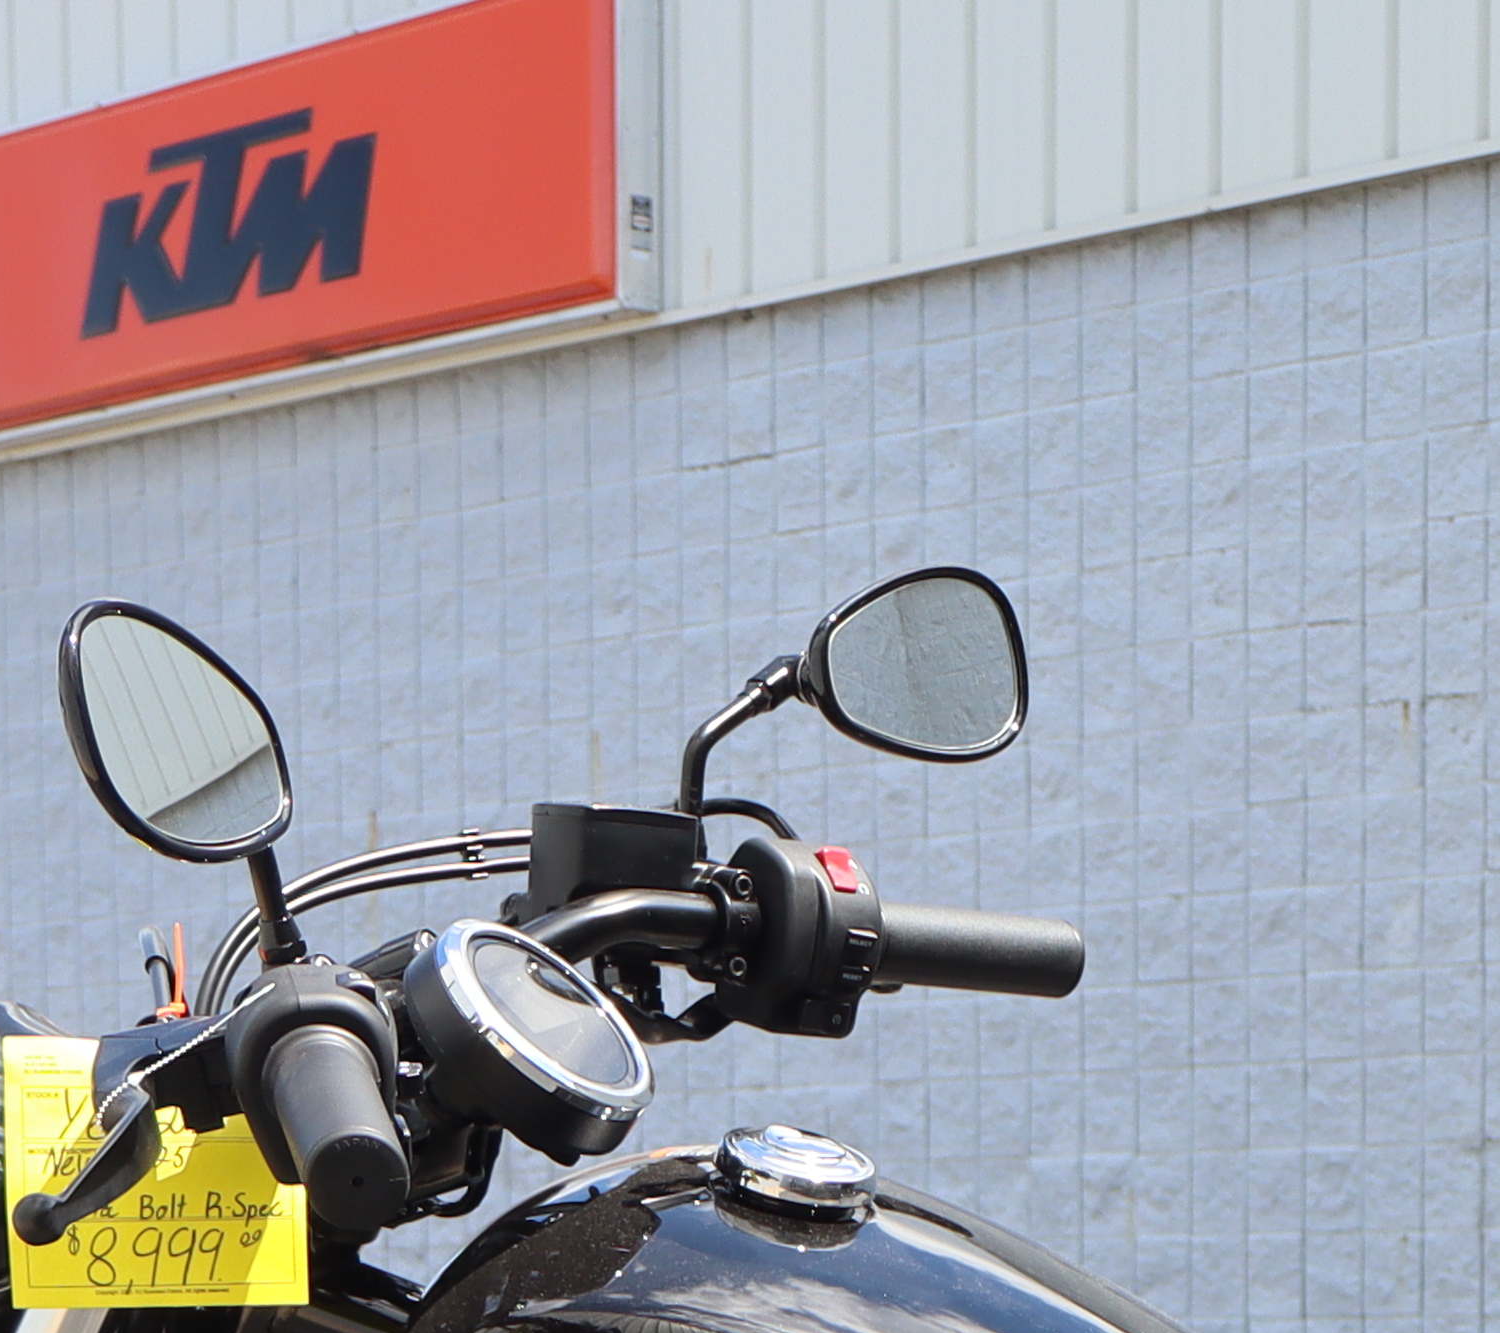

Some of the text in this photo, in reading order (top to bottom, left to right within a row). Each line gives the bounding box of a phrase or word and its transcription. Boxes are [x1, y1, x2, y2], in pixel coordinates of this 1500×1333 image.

[80, 107, 376, 339] KTM
[139, 1193, 187, 1220] Bolt
[205, 1191, 284, 1227] R-Spec
